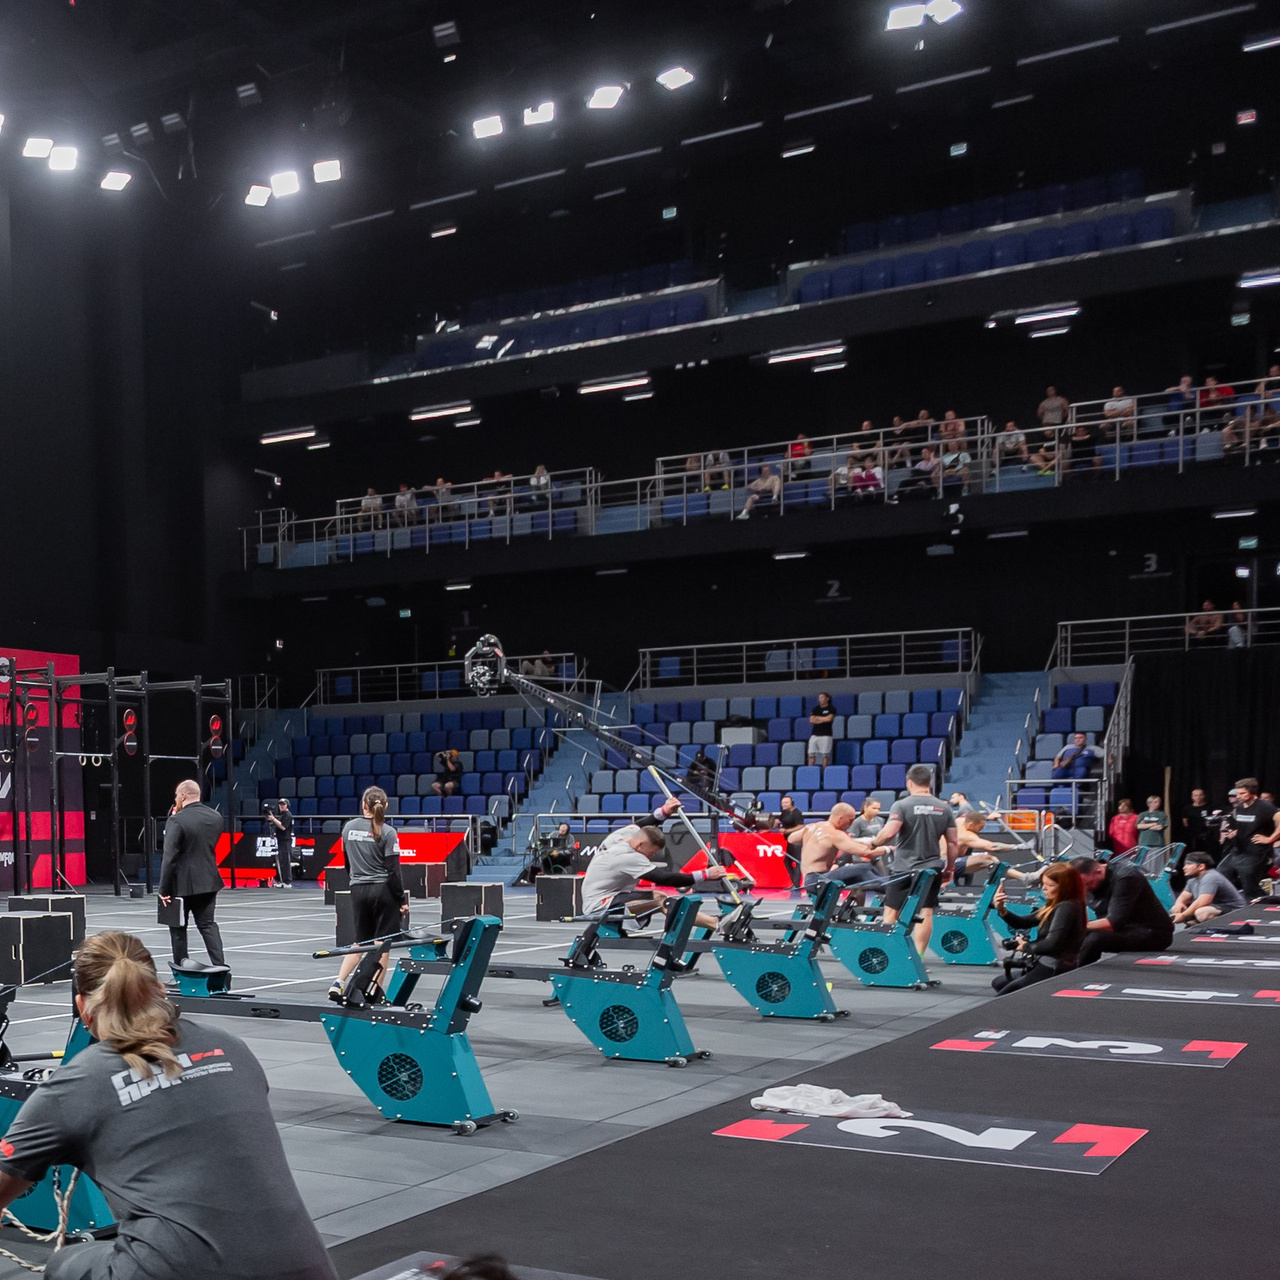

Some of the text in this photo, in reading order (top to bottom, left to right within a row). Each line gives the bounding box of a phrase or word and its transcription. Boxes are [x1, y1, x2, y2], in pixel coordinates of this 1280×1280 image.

[1145, 553, 1158, 573] 3
[826, 580, 841, 597] 2
[756, 845, 784, 857] TYR
[1121, 987, 1241, 1000] 4
[1011, 1036, 1163, 1054] 3
[836, 1118, 1037, 1150] 2
